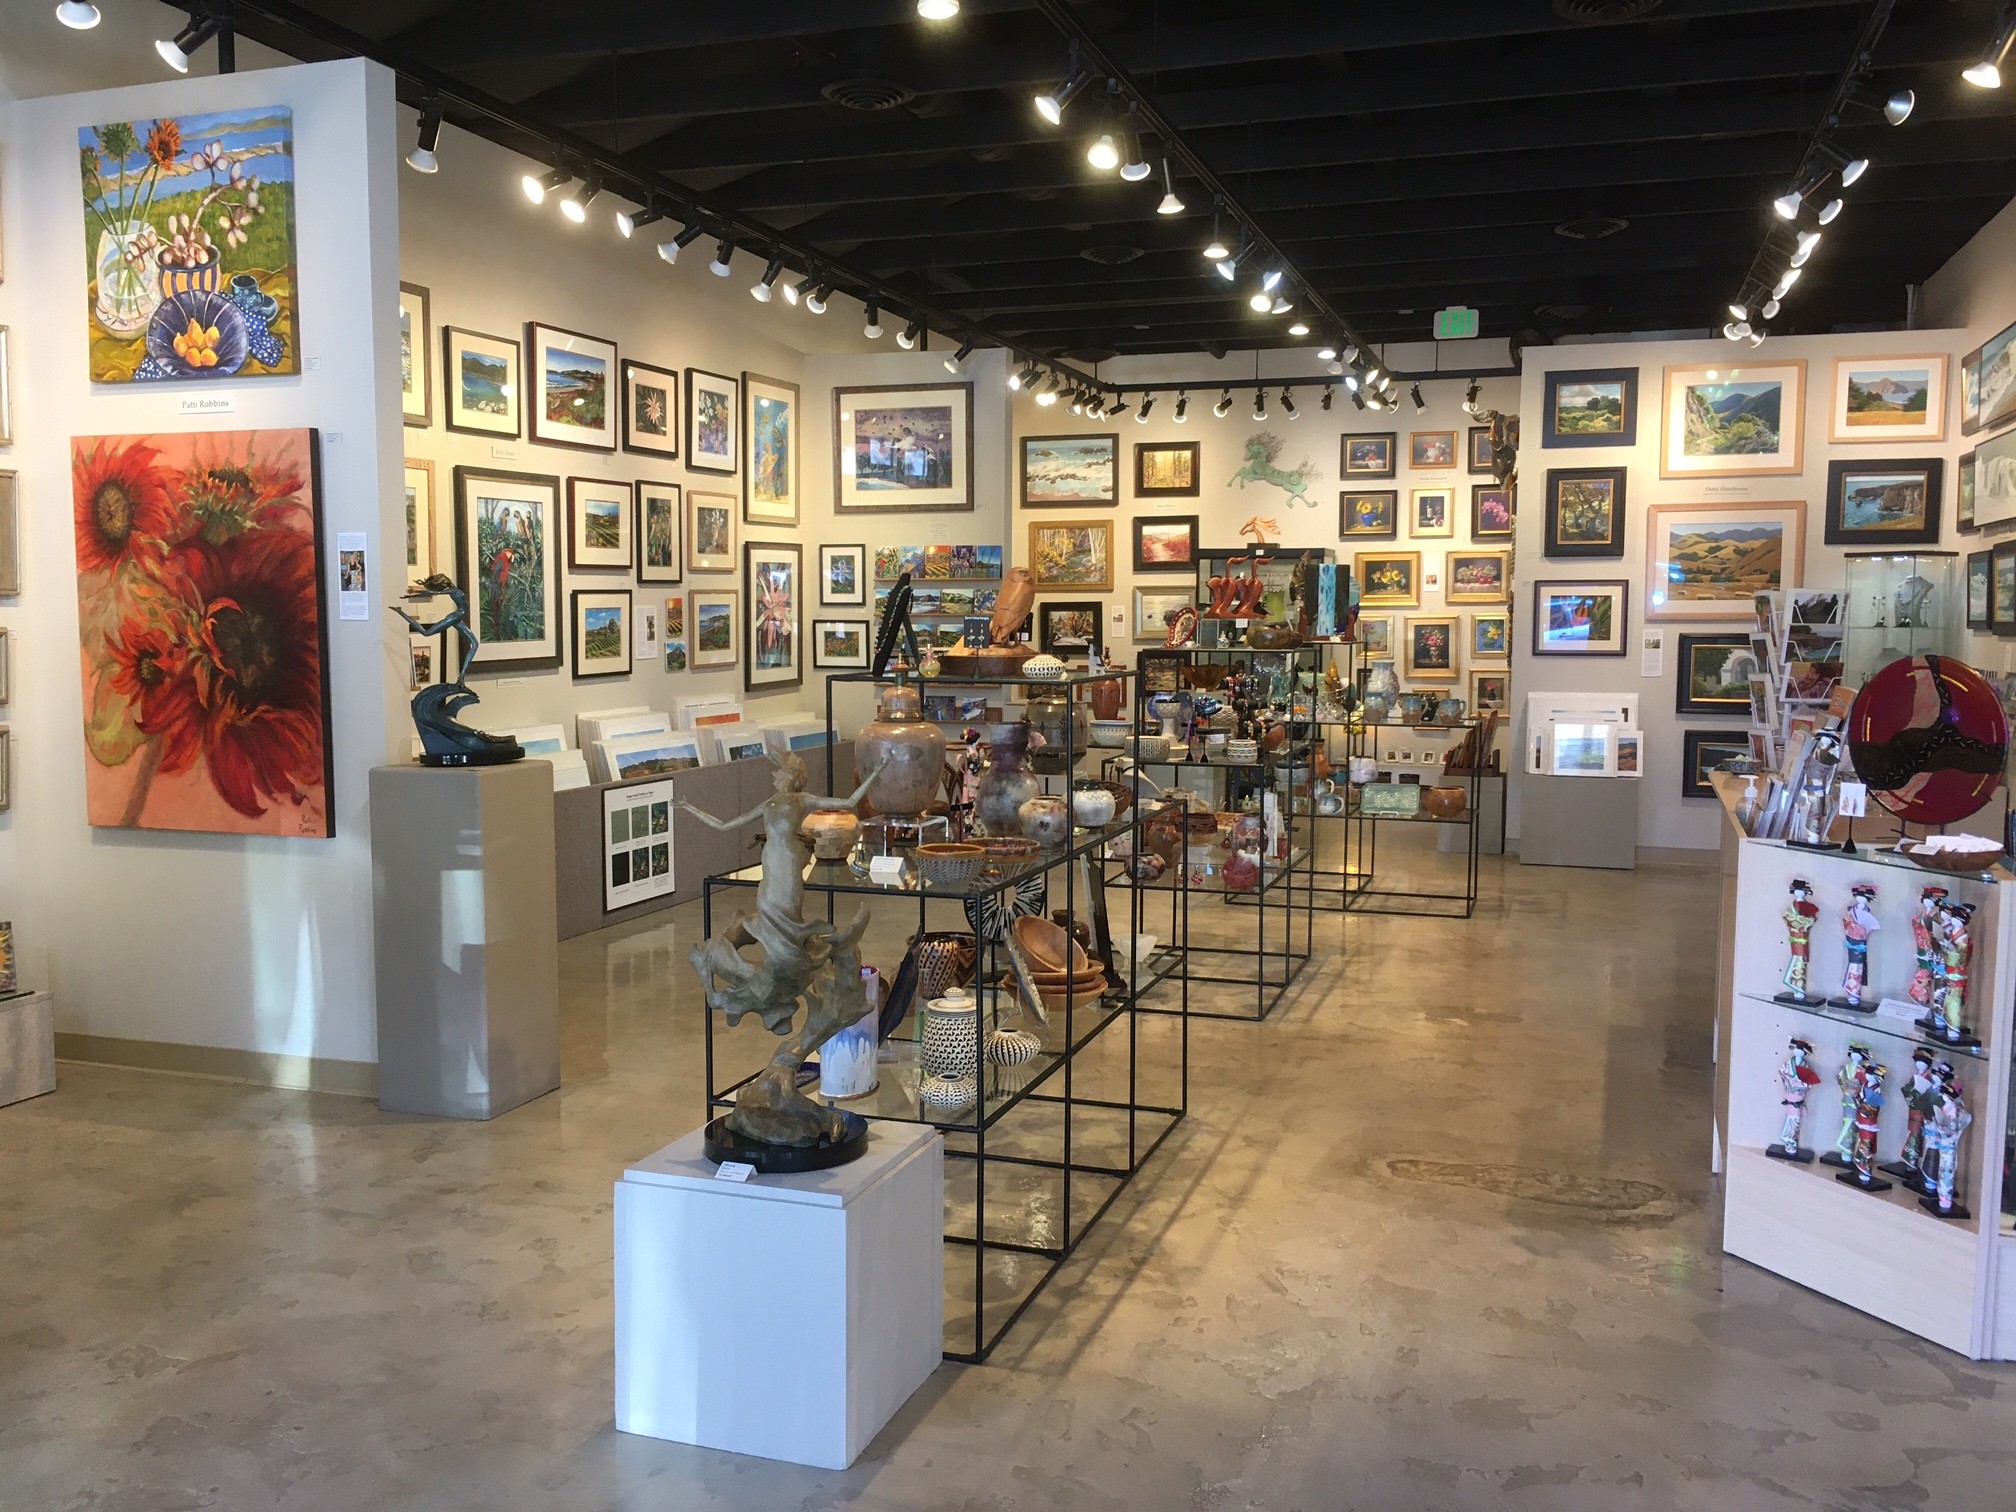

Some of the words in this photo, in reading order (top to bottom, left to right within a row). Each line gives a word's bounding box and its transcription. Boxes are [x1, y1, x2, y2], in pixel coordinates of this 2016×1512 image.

[1441, 310, 1473, 336] EXIT
[182, 400, 198, 409] Patti
[199, 399, 229, 408] Robbins
